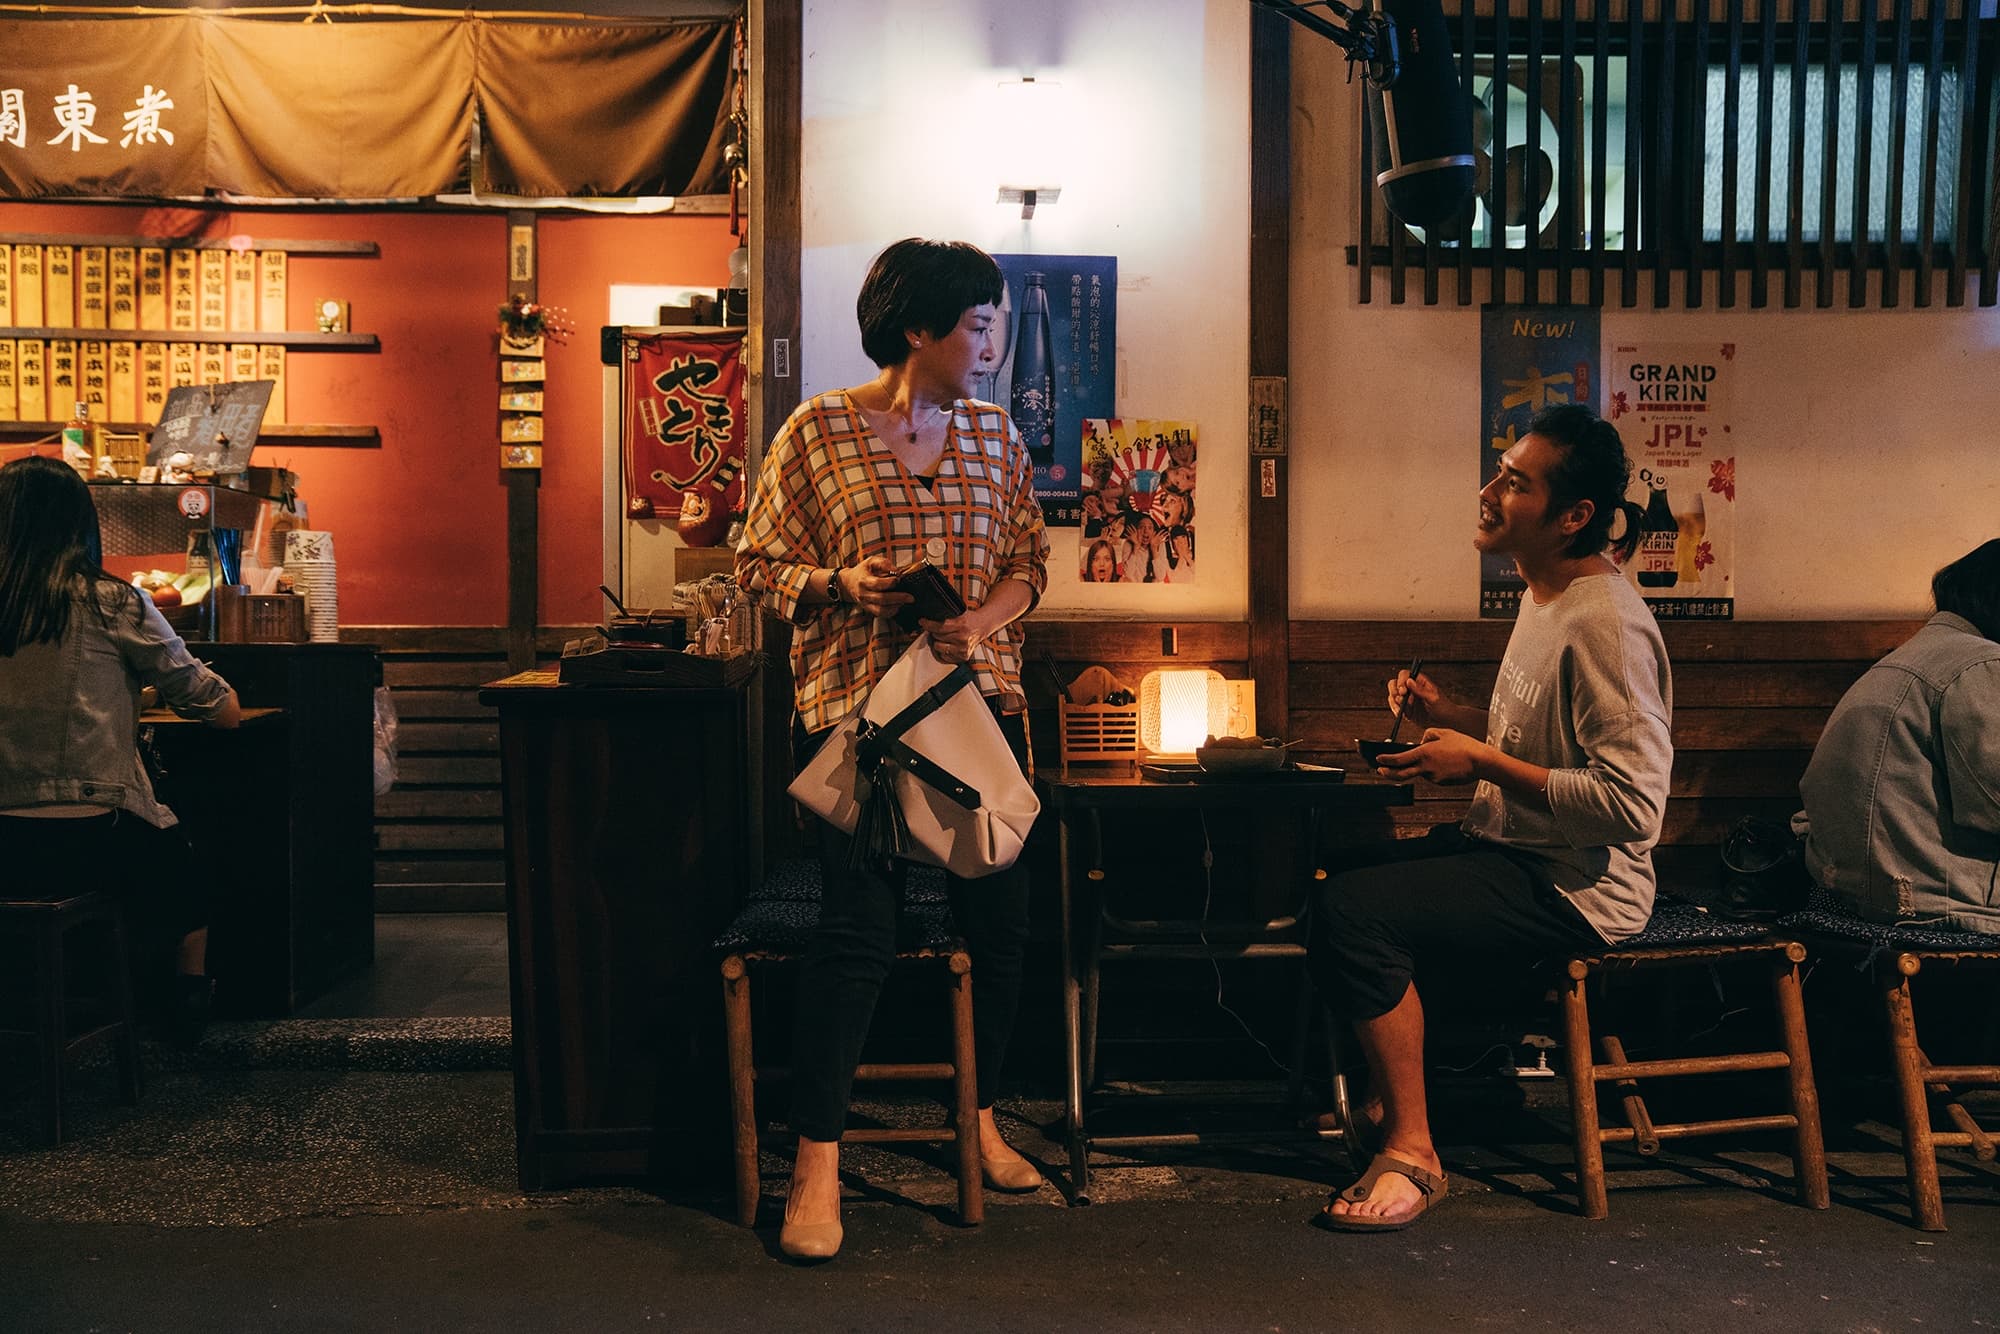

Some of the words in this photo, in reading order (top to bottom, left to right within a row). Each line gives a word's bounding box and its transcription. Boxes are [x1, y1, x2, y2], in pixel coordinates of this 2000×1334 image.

[1512, 319, 1575, 337] New!
[1629, 364, 1717, 382] GRAND
[1639, 384, 1708, 402] KIRIN
[653, 354, 731, 491] やきとり
[1644, 424, 1702, 448] JPL
[1642, 541, 1674, 550] KIRIN
[1646, 560, 1672, 571] JPL
